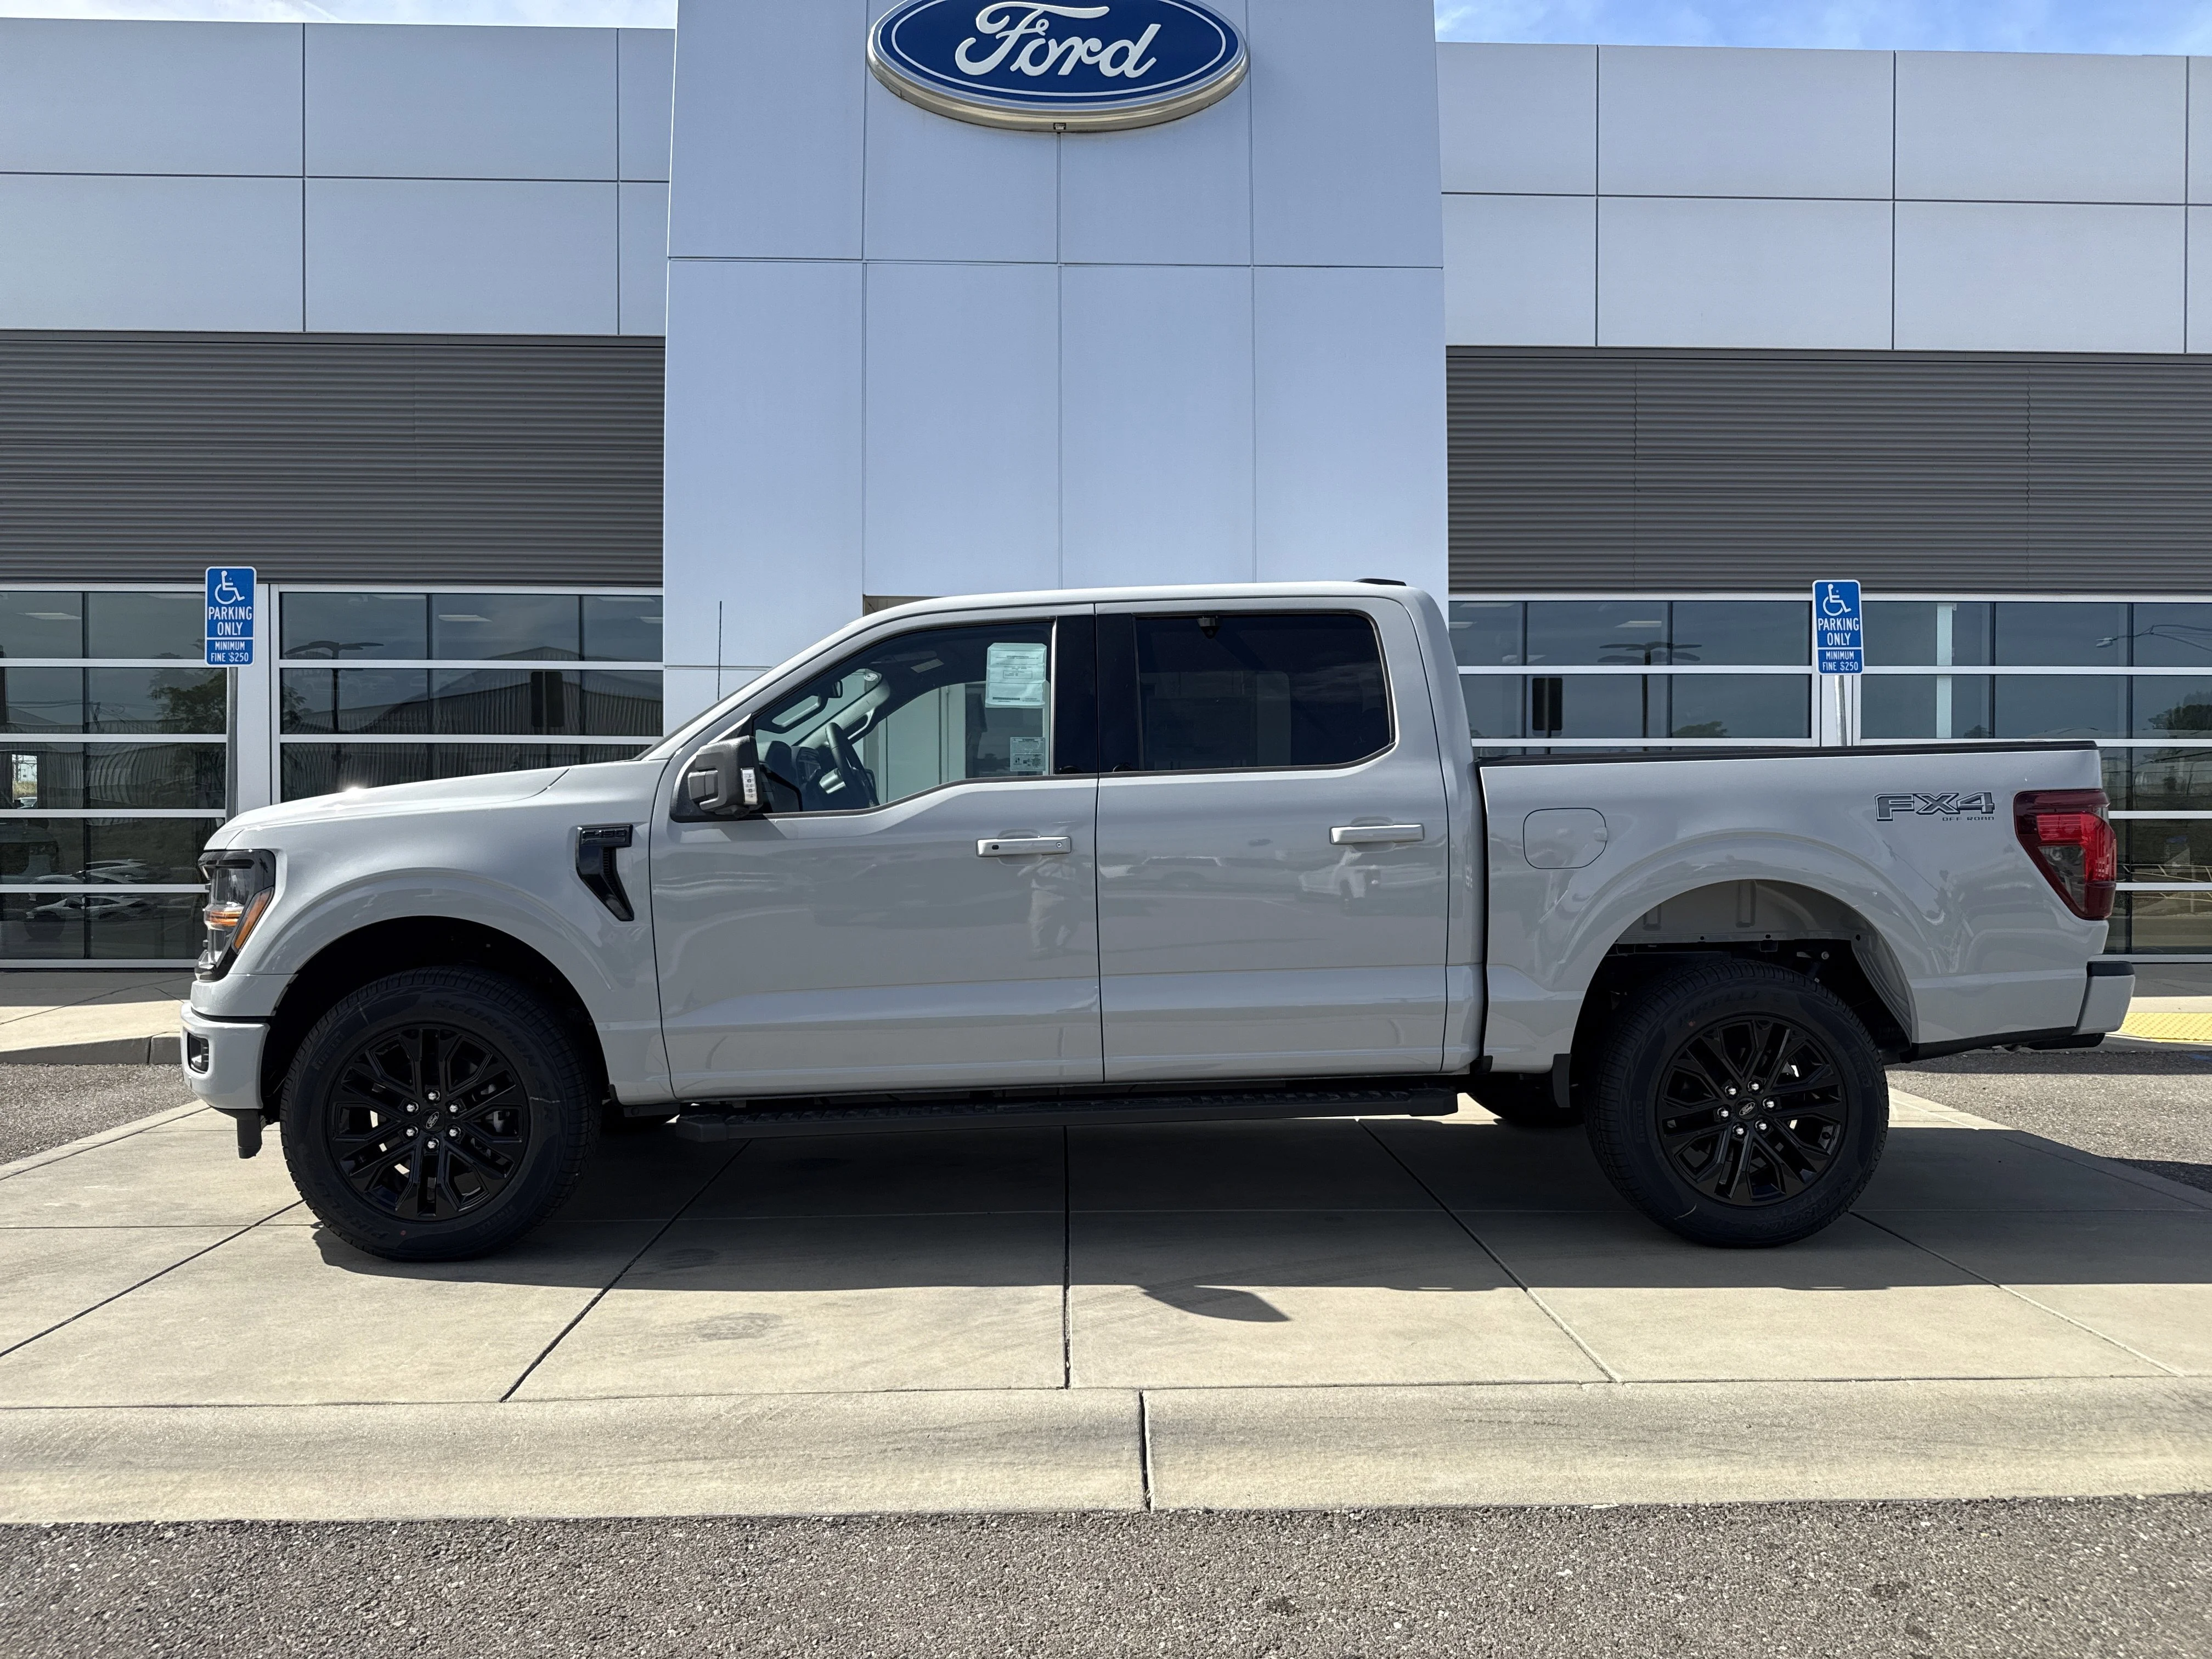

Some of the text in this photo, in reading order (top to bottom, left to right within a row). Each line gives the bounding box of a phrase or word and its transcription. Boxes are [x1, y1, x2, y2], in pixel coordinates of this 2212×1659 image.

[955, 1, 1161, 78] Ford
[208, 606, 252, 620] PARKING
[217, 622, 243, 636] ONLY
[1818, 618, 1859, 631] PARKING
[215, 641, 245, 651] MINIMUM
[1827, 633, 1851, 646] ONLY
[211, 652, 249, 662] FINE $250
[1826, 651, 1854, 660] MINIMUM
[1822, 661, 1859, 672] FINE $250
[1875, 792, 1995, 822] FX4
[431, 998, 540, 1068] SCORPION
[313, 1180, 391, 1240] PIRELLI
